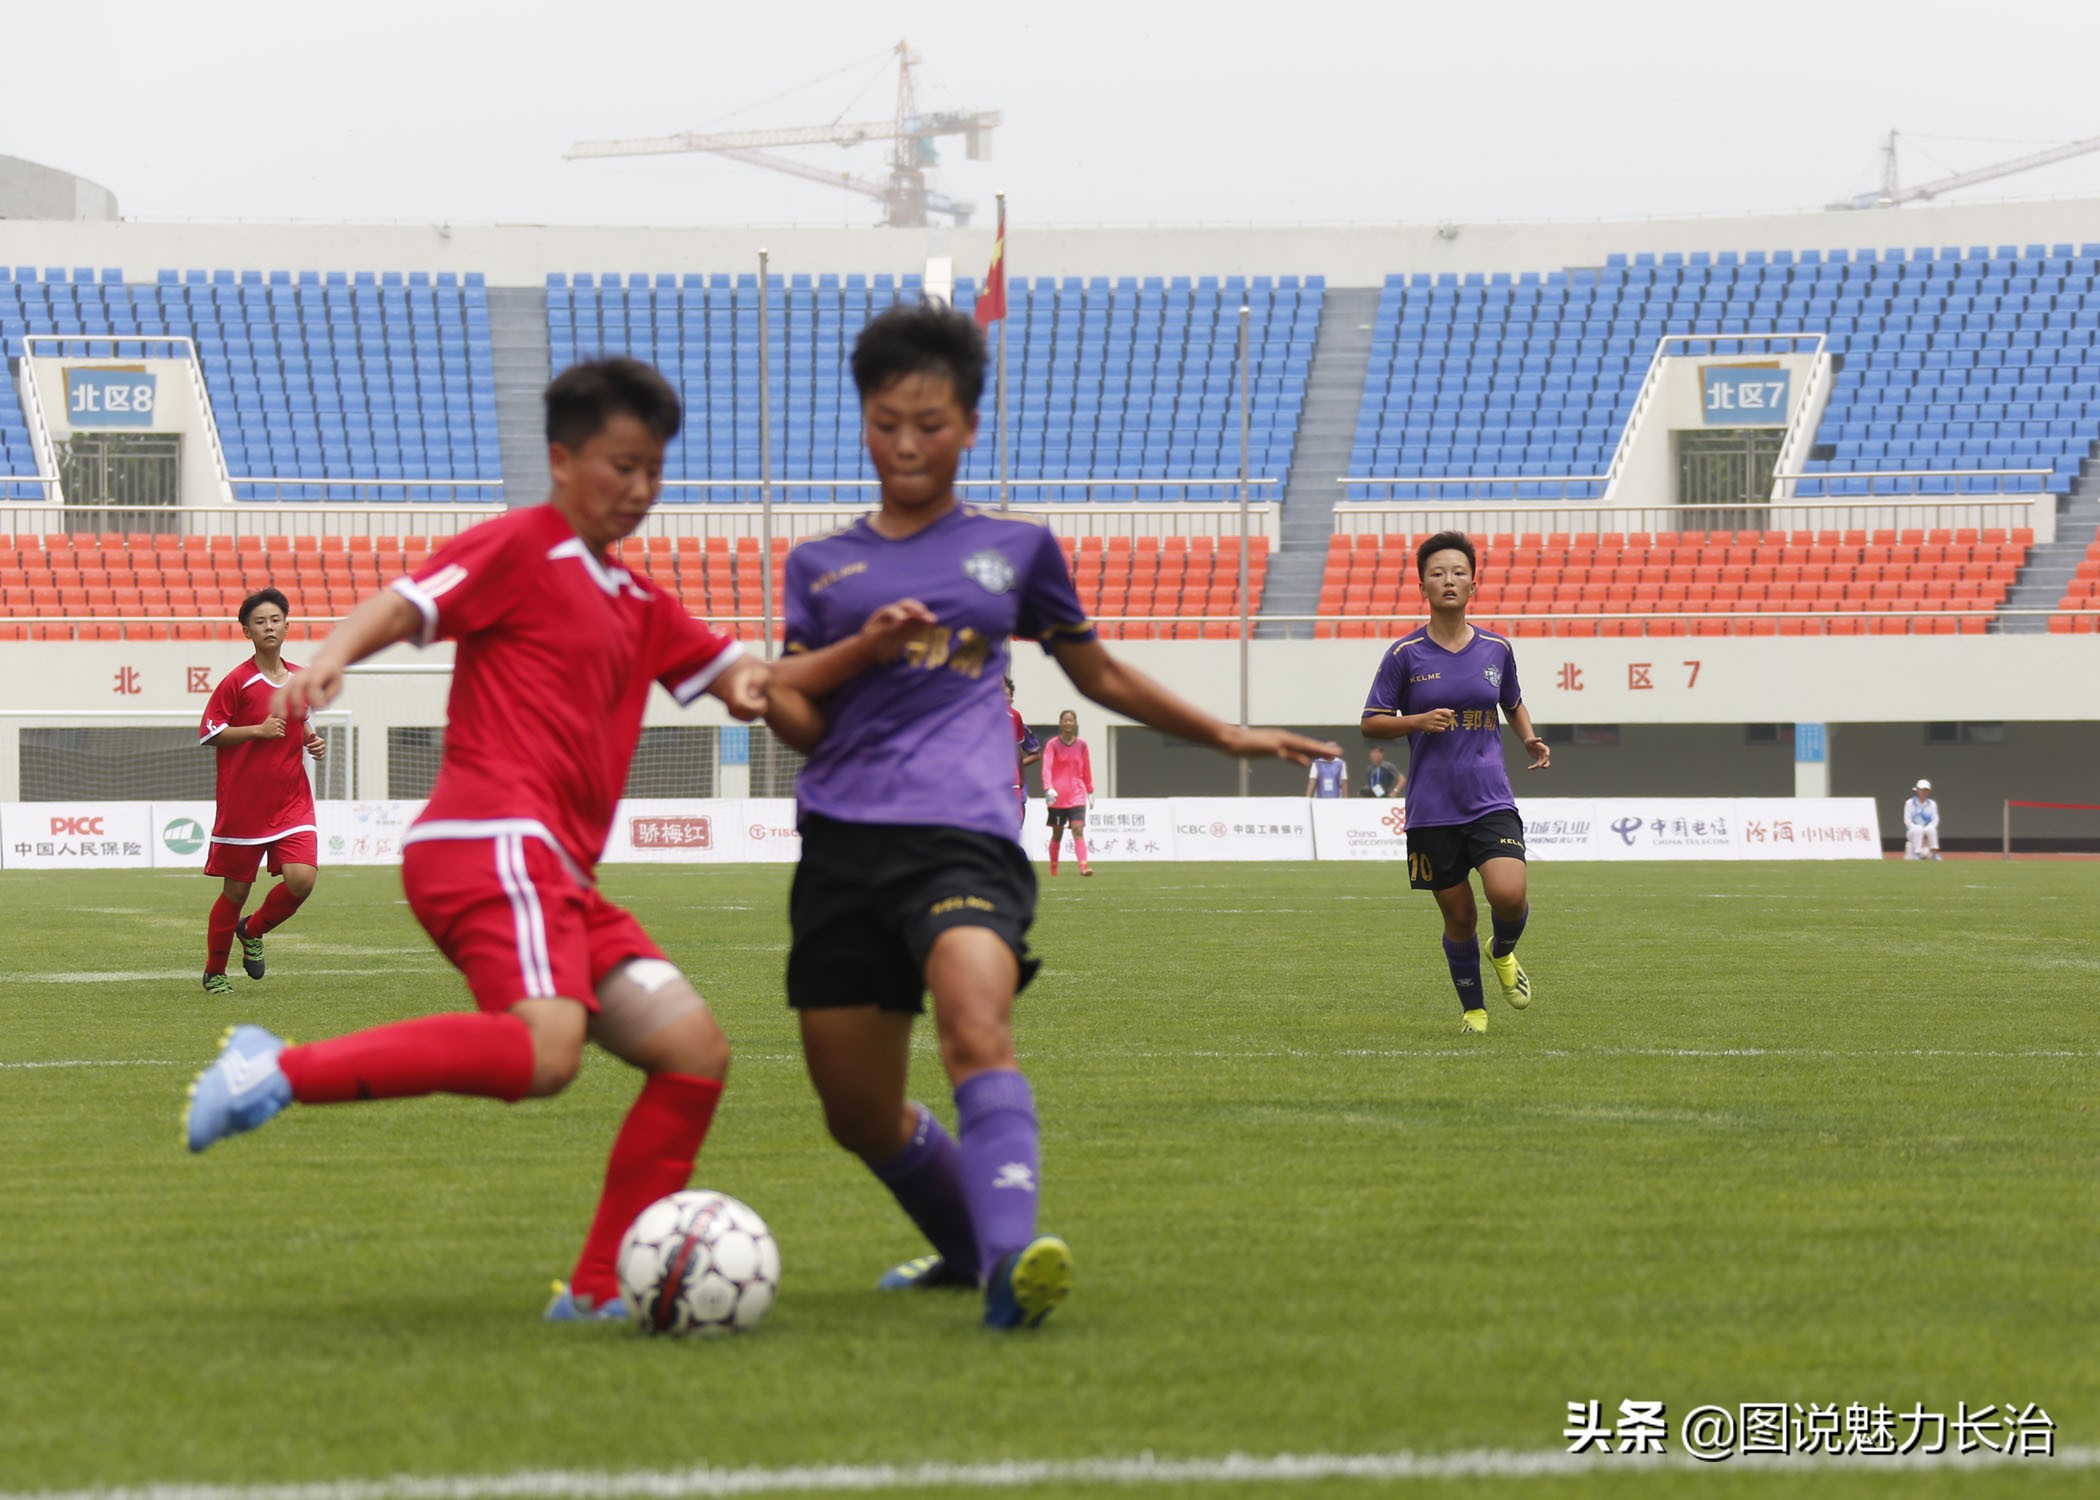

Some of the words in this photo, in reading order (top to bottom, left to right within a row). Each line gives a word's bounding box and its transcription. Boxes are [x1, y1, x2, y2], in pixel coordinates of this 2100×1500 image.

[71, 383, 153, 413] 北区8
[1706, 381, 1785, 410] 北区7
[1409, 672, 1441, 684] KELME
[50, 817, 104, 836] PICC
[769, 828, 800, 838] TISC
[1177, 824, 1206, 834] ICBC
[1233, 824, 1304, 835] 中国工商银行
[1346, 829, 1377, 838] China
[1650, 817, 1727, 838] 中国电信
[1745, 820, 1794, 843] 汾酒
[15, 841, 142, 857] 中国人民保险
[1408, 851, 1433, 882] 10
